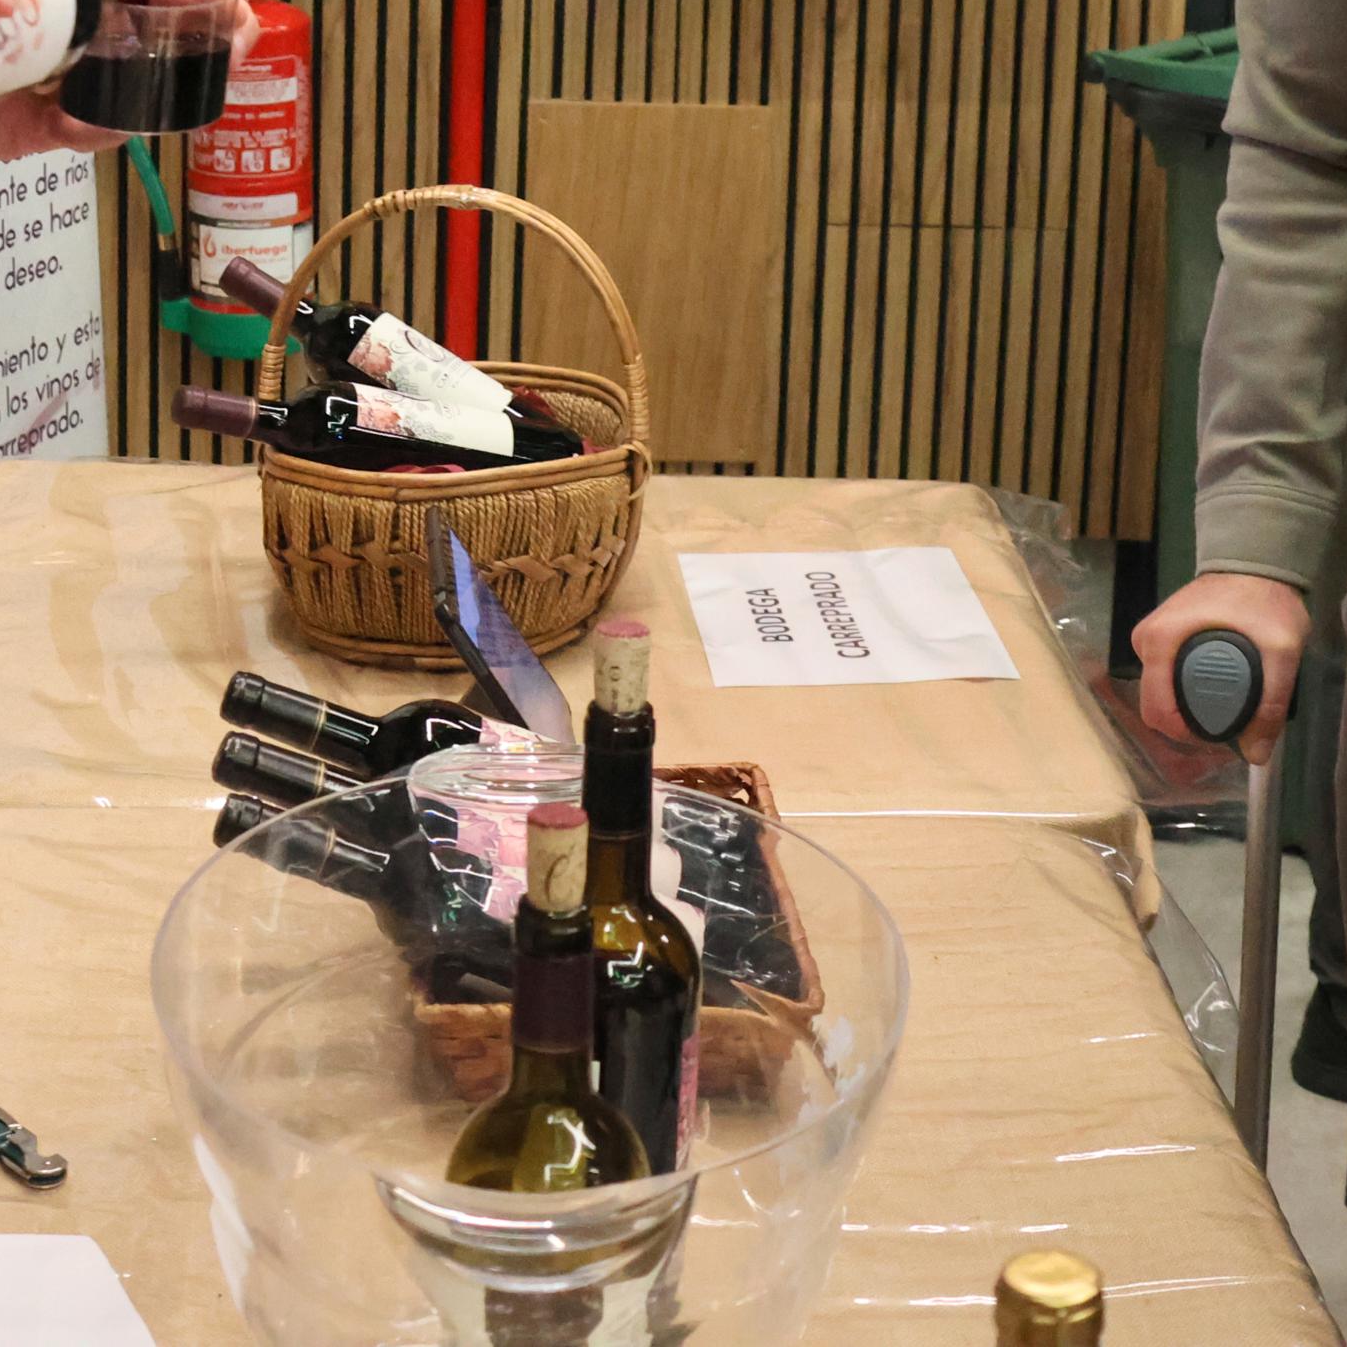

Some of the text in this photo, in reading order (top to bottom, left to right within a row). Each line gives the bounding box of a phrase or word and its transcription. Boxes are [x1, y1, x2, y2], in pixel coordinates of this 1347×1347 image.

[35, 163, 59, 196] de
[65, 155, 89, 187] ríos
[24, 219, 43, 242] se
[50, 201, 90, 234] hace
[4, 254, 63, 291] deseo.
[56, 333, 67, 363] y
[5, 385, 28, 418] los
[35, 369, 80, 403] vinos
[85, 347, 101, 381] de
[746, 587, 794, 643] BODEGA
[805, 571, 871, 659] CARREPRADO
